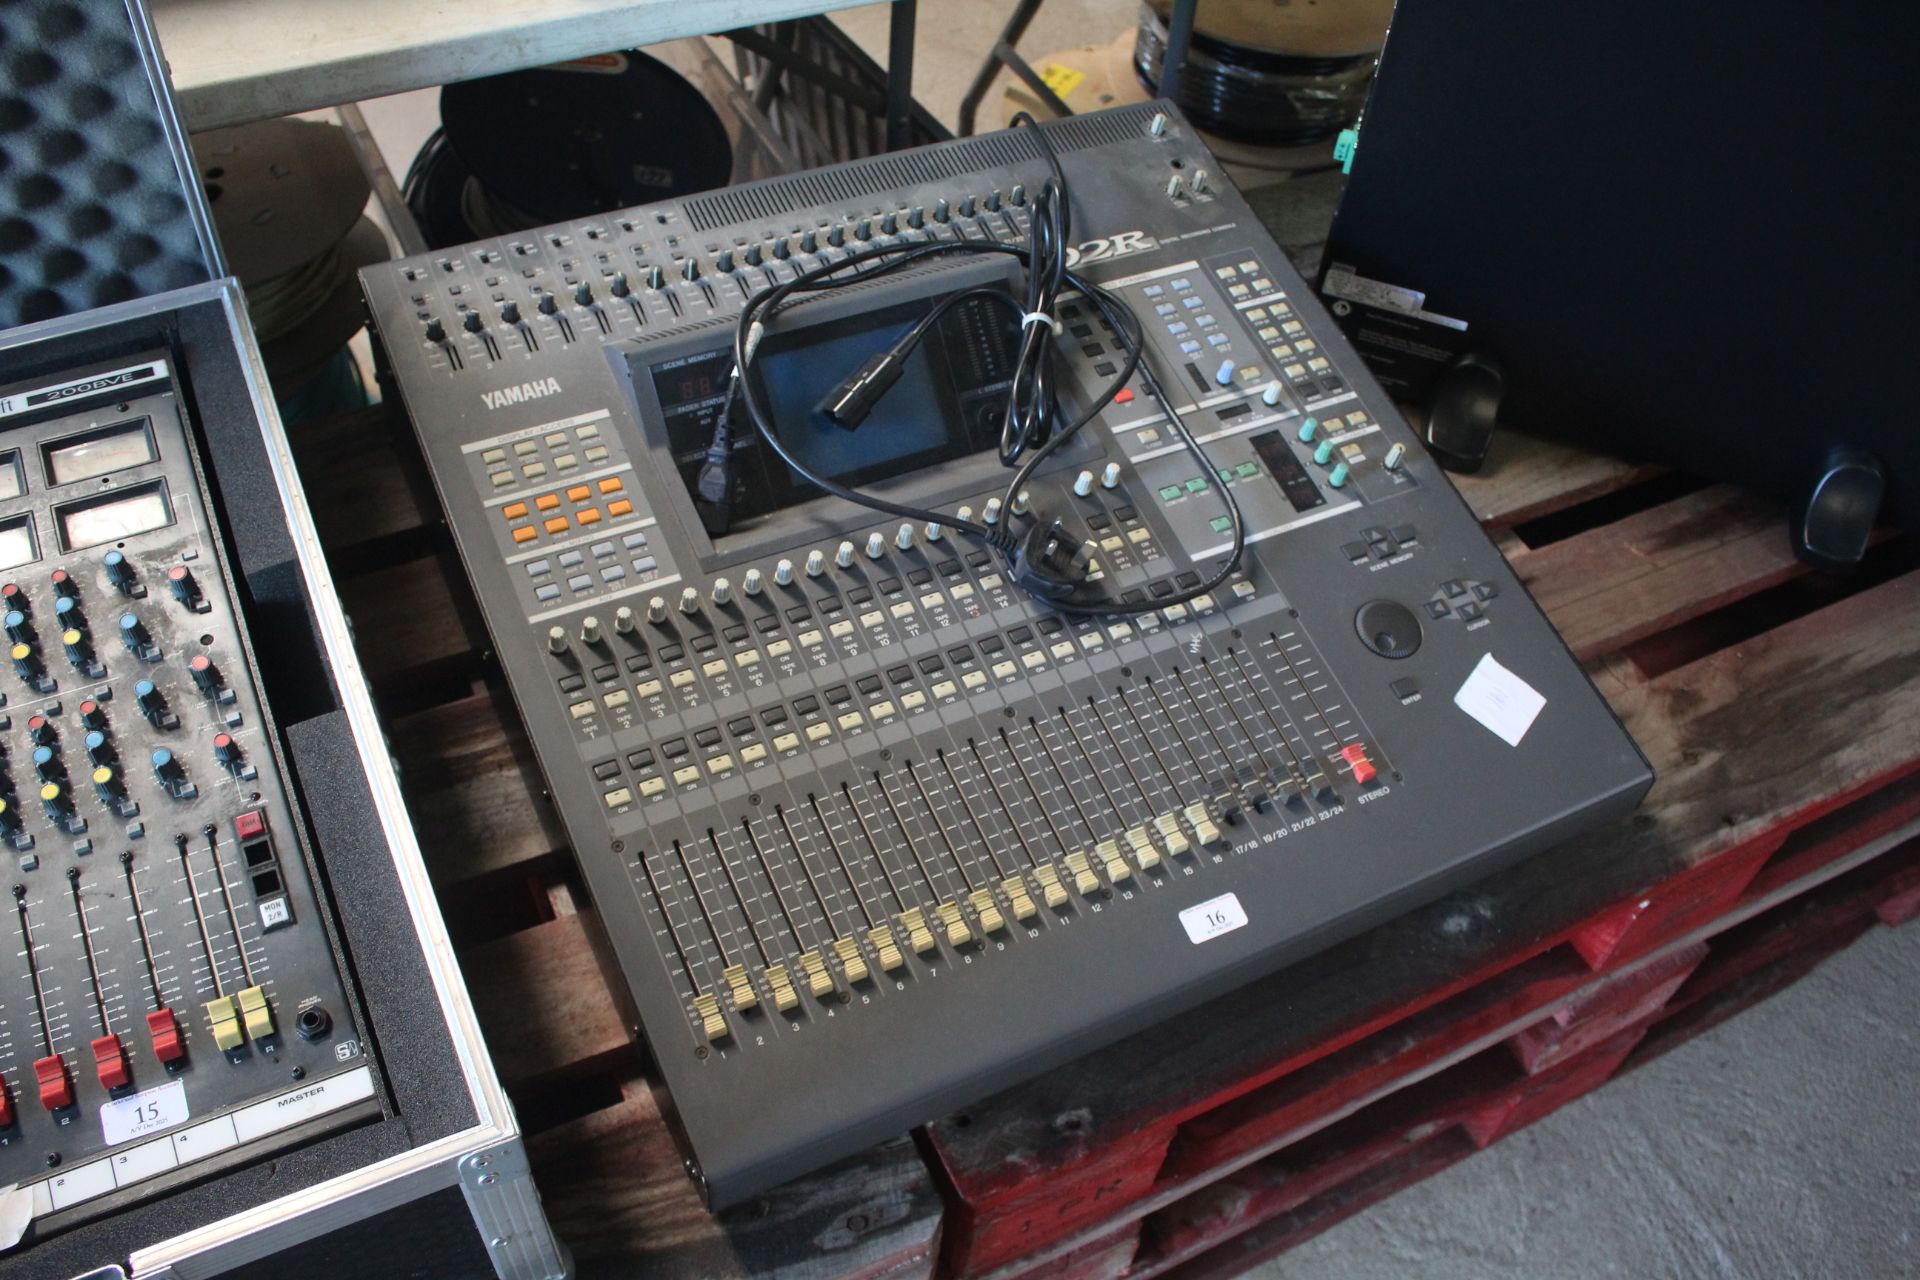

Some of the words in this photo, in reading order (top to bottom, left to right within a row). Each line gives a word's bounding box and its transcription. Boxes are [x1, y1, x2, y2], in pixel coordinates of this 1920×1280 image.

[662, 358, 685, 370] SCENE
[687, 351, 717, 363] MEMORY
[47, 373, 133, 400] 200BVE
[480, 376, 562, 411] YAMAHA
[677, 402, 699, 414] FADER
[1369, 562, 1389, 573] SCENE
[1390, 552, 1414, 565] MEMORY
[994, 594, 1008, 603] TAPE
[999, 600, 1009, 609] 14
[935, 614, 950, 622] TAPE
[904, 623, 920, 632] TAPE
[940, 619, 950, 627] 12
[1466, 618, 1491, 632] CURSOR
[874, 632, 890, 641] TAPE
[910, 629, 920, 638] 11
[880, 638, 890, 647] 10
[1122, 636, 1131, 644] ON
[844, 642, 858, 651] TAPE
[1093, 646, 1103, 654] ON
[812, 652, 827, 661] TAPE
[850, 648, 858, 656] 9
[780, 662, 796, 670] TAPE
[820, 658, 827, 666] 8
[748, 672, 764, 681] TAPE
[788, 668, 794, 677] 7
[716, 682, 732, 691] TAPE
[755, 678, 762, 686] 6
[683, 693, 699, 702] TAPE
[723, 689, 730, 697] 5
[946, 696, 956, 704] ON
[1401, 693, 1422, 706] ENTER
[650, 704, 666, 712] TAPE
[616, 714, 632, 722] TAPE
[657, 710, 664, 718] 3
[582, 724, 598, 734] TAPE
[590, 732, 595, 740] 1
[674, 756, 687, 764] SEL
[720, 772, 731, 780] ON
[606, 778, 619, 786] SEL
[652, 794, 664, 802] ON
[1358, 786, 1391, 805] STEREO
[618, 806, 629, 814] ON
[1235, 840, 1259, 855] 17/18
[1262, 828, 1288, 844] 19/20
[1291, 816, 1317, 832] 21/22
[1318, 805, 1344, 821] 23/24
[264, 901, 281, 911] MON
[1206, 910, 1226, 926] 16
[720, 1051, 726, 1060] 1
[756, 1036, 764, 1046] 2
[792, 1022, 800, 1032] 3
[828, 1009, 835, 1018] 4
[862, 995, 870, 1004] 5
[896, 982, 905, 991] 6
[930, 968, 937, 978] 7
[964, 955, 972, 964] 8
[996, 942, 1005, 951] 9
[1028, 928, 1039, 939] 10
[1060, 916, 1071, 926] 11
[1092, 903, 1102, 913] 12
[1122, 890, 1134, 900] 13
[1153, 878, 1164, 888] 14
[1182, 866, 1194, 876] 15
[1212, 854, 1224, 864] 16
[265, 1045, 274, 1054] R
[277, 1086, 325, 1108] MASTER
[134, 1100, 159, 1124] 15
[61, 1118, 70, 1126] 2
[120, 1156, 128, 1164] 3
[56, 1178, 65, 1186] 2
